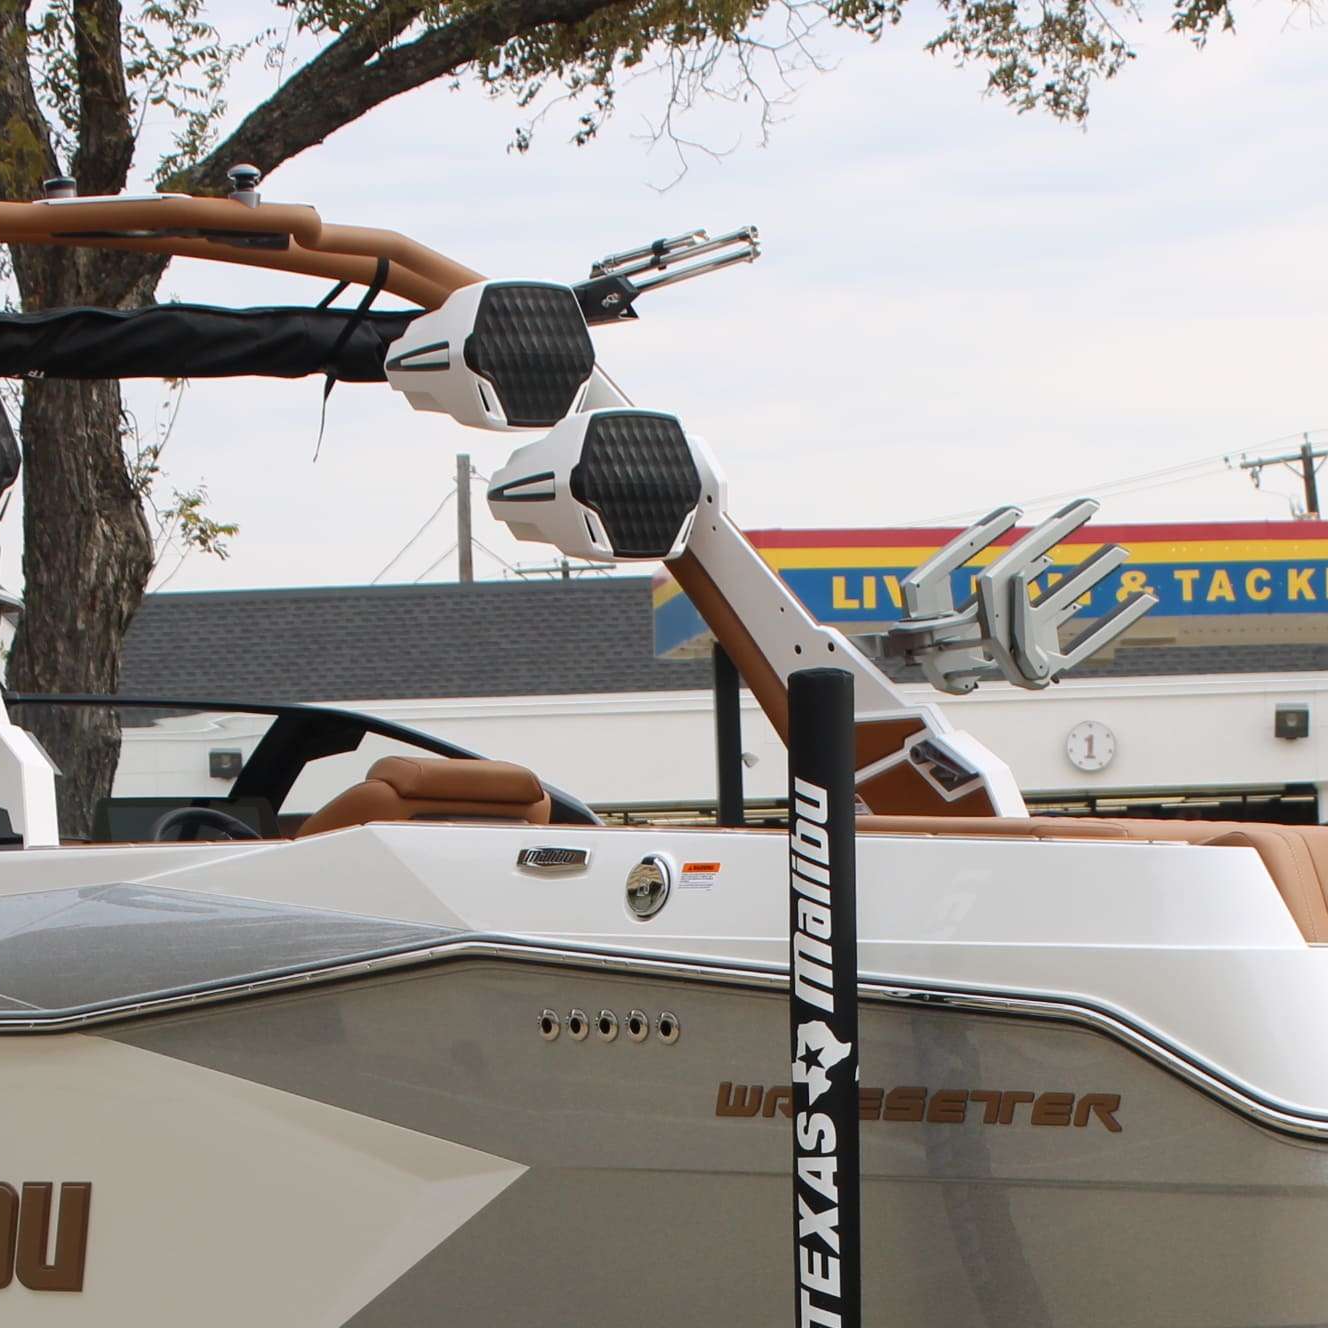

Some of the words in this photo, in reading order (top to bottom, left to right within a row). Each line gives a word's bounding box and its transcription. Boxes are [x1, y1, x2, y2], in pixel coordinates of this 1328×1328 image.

[832, 574, 908, 609] LIV
[1115, 569, 1156, 603] &
[1083, 734, 1097, 760] 1
[790, 776, 835, 1014] Malibu
[715, 1080, 1123, 1133] WAESETTER
